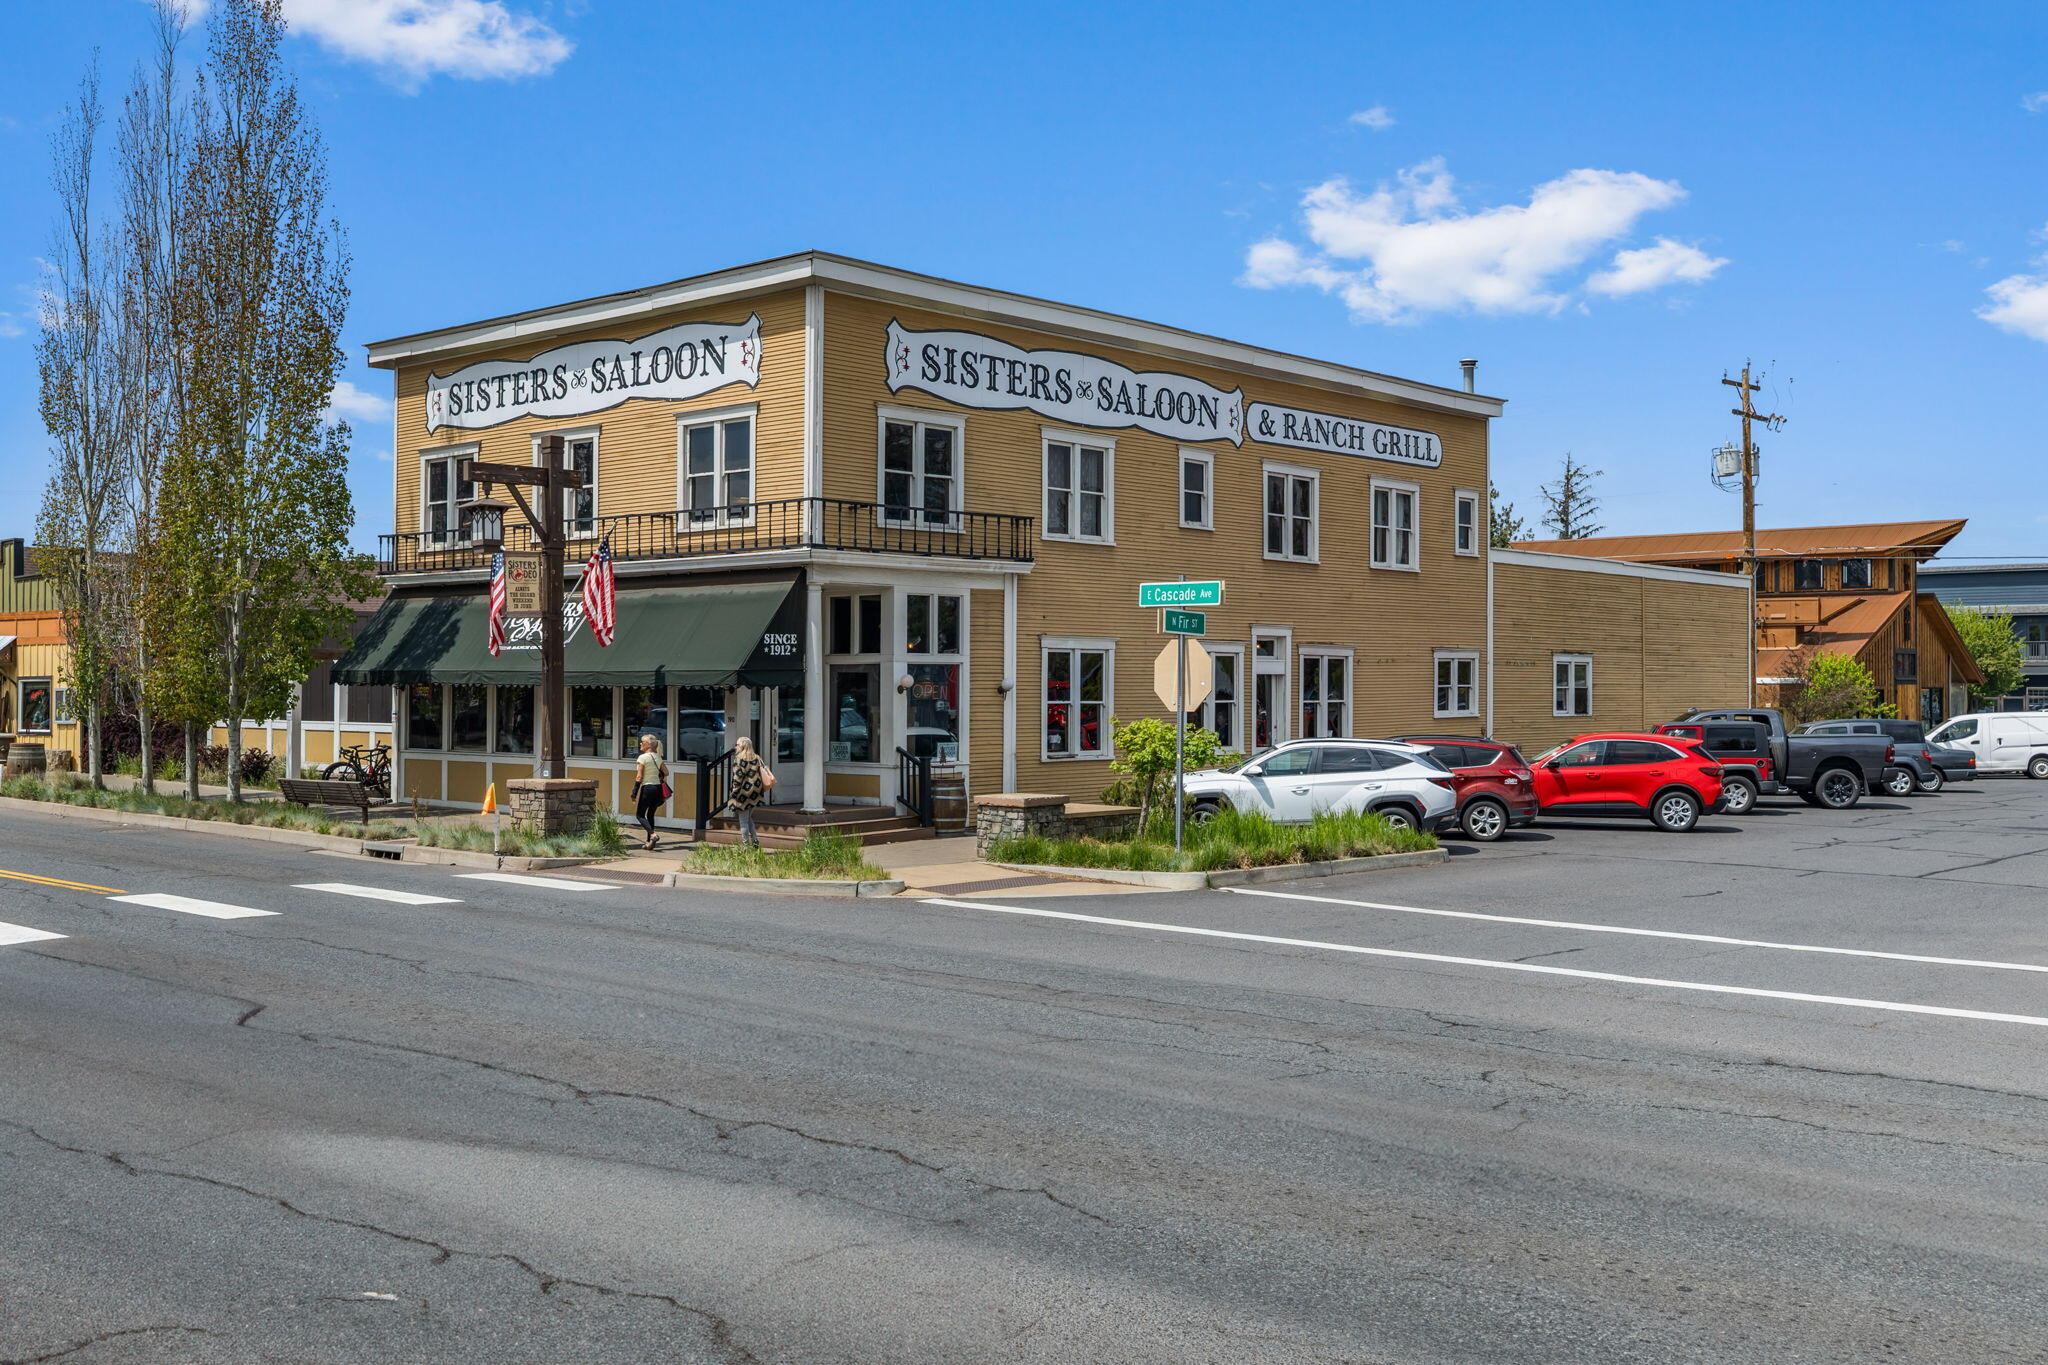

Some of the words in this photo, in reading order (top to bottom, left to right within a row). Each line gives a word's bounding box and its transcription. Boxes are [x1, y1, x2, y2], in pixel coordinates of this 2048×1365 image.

[449, 363, 568, 416] SISTERS
[591, 335, 728, 393] SALOON
[921, 343, 1072, 405] SISTERS
[1097, 376, 1219, 430] SALOON
[1259, 409, 1276, 436] &
[1282, 413, 1365, 451] RANCH
[1373, 431, 1438, 462] GRILL
[1147, 590, 1152, 600] E
[1154, 588, 1196, 601] Cascade
[1200, 589, 1212, 598] Ave
[1172, 617, 1177, 626] N
[1178, 616, 1189, 629] Fir
[764, 633, 797, 645] SINCE
[770, 645, 791, 655] 1912
[912, 683, 949, 700] OPEN
